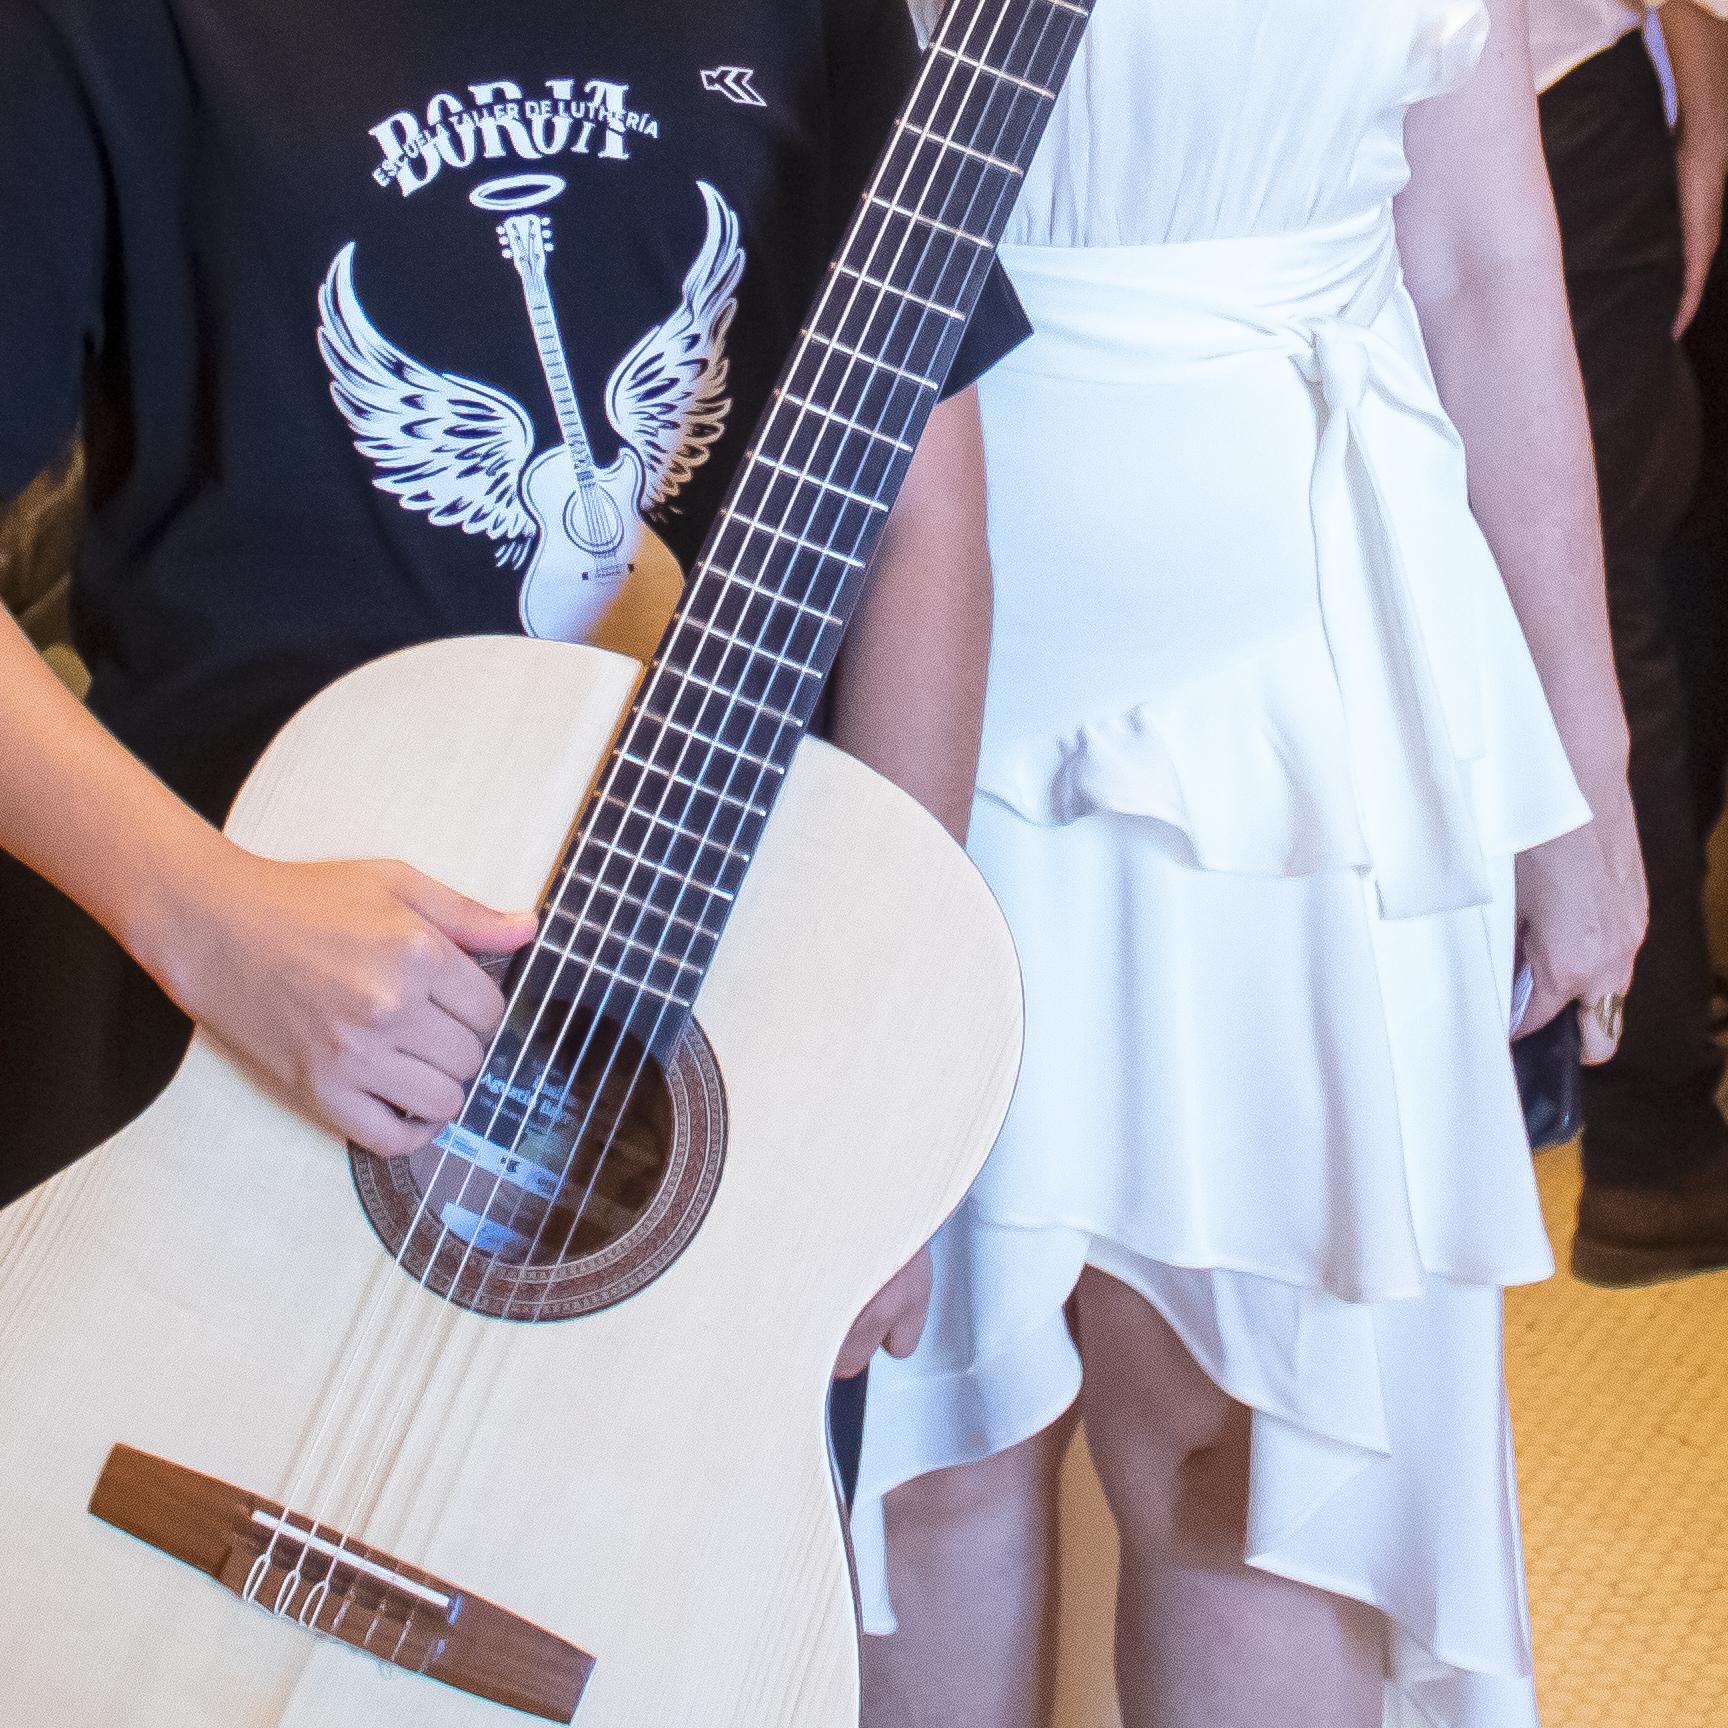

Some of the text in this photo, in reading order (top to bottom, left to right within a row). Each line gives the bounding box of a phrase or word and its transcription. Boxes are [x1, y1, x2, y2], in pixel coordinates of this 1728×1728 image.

[368, 78, 630, 198] BORJA
[372, 100, 658, 187] ESCUELA TALLER DE LUTHERÍA
